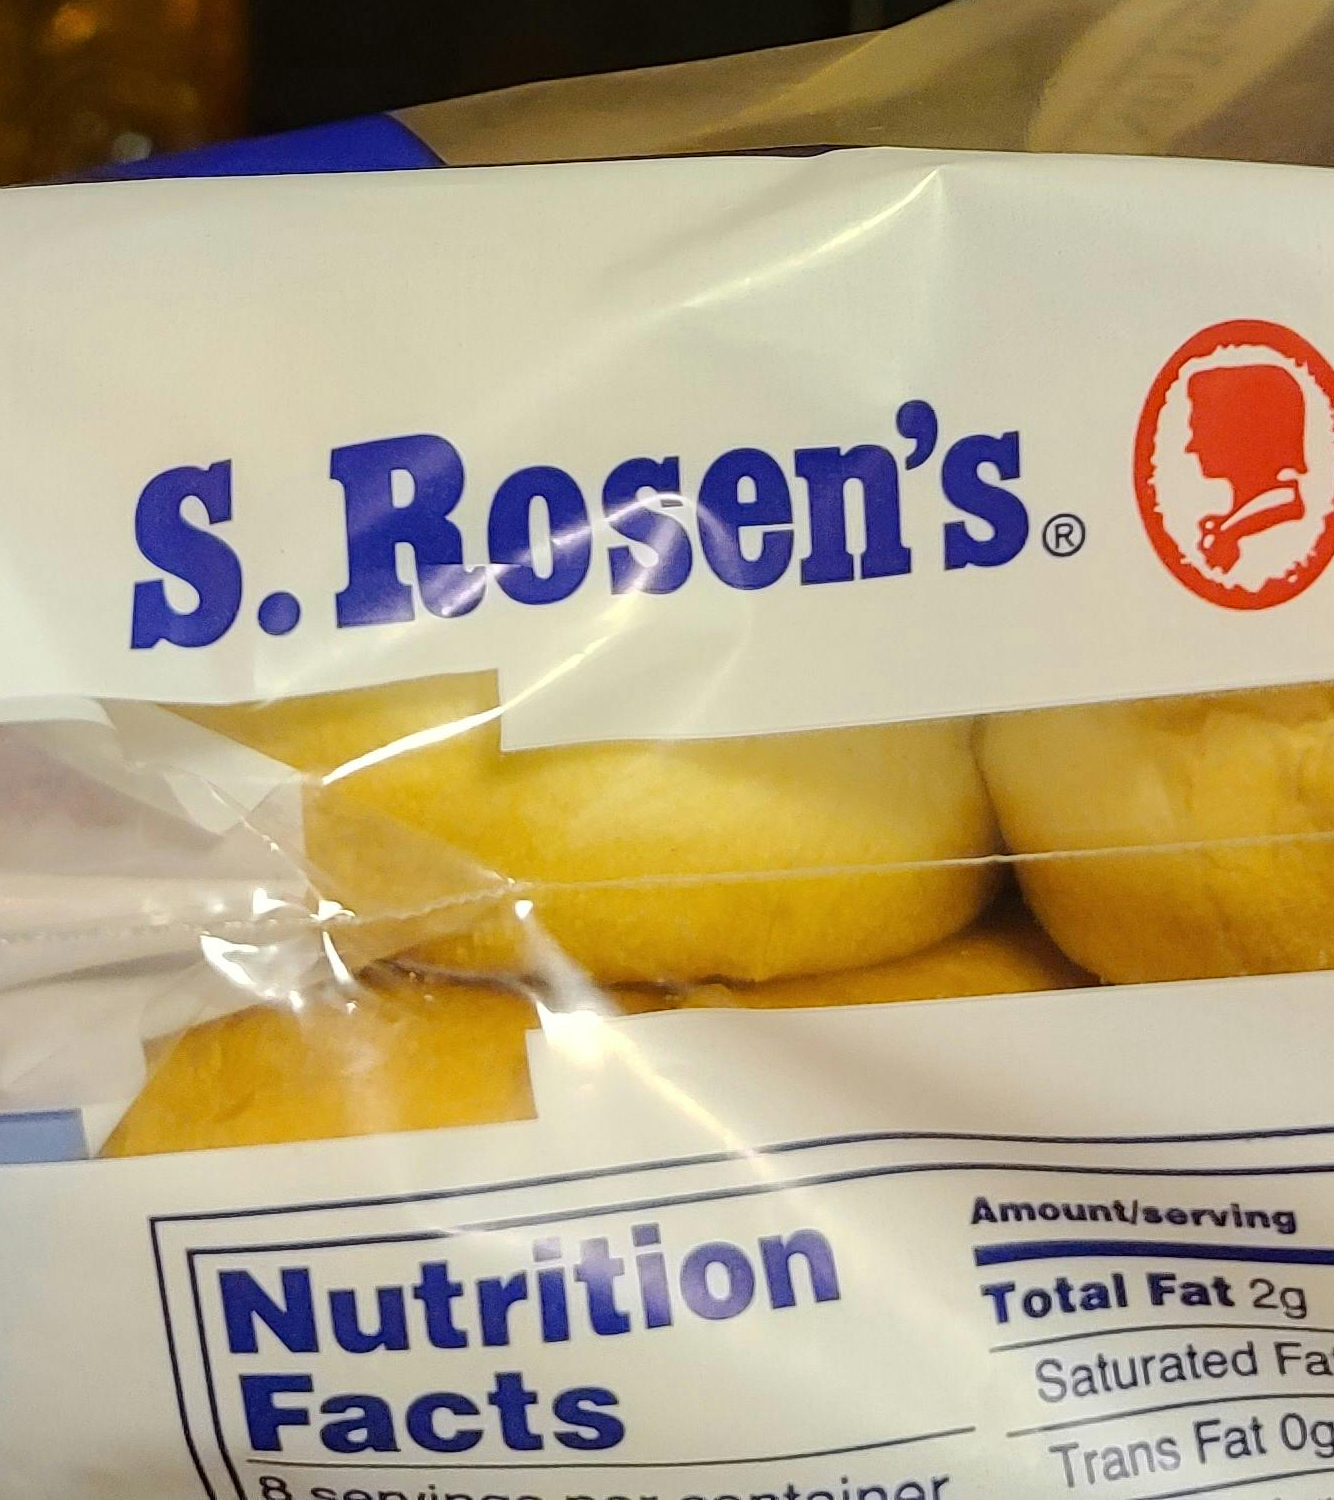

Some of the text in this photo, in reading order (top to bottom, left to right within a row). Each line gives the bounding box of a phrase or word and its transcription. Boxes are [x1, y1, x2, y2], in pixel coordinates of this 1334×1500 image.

[130, 458, 301, 651] S.
[970, 1195, 1299, 1235] Amount/serving
[219, 1223, 842, 1357] Nutrition
[980, 1272, 1308, 1325] Total Fat 2g
[1035, 1340, 1259, 1404] Saturated
[241, 1370, 627, 1455] Facts
[1048, 1434, 1182, 1489] Trans
[1192, 1415, 1267, 1464] Fat
